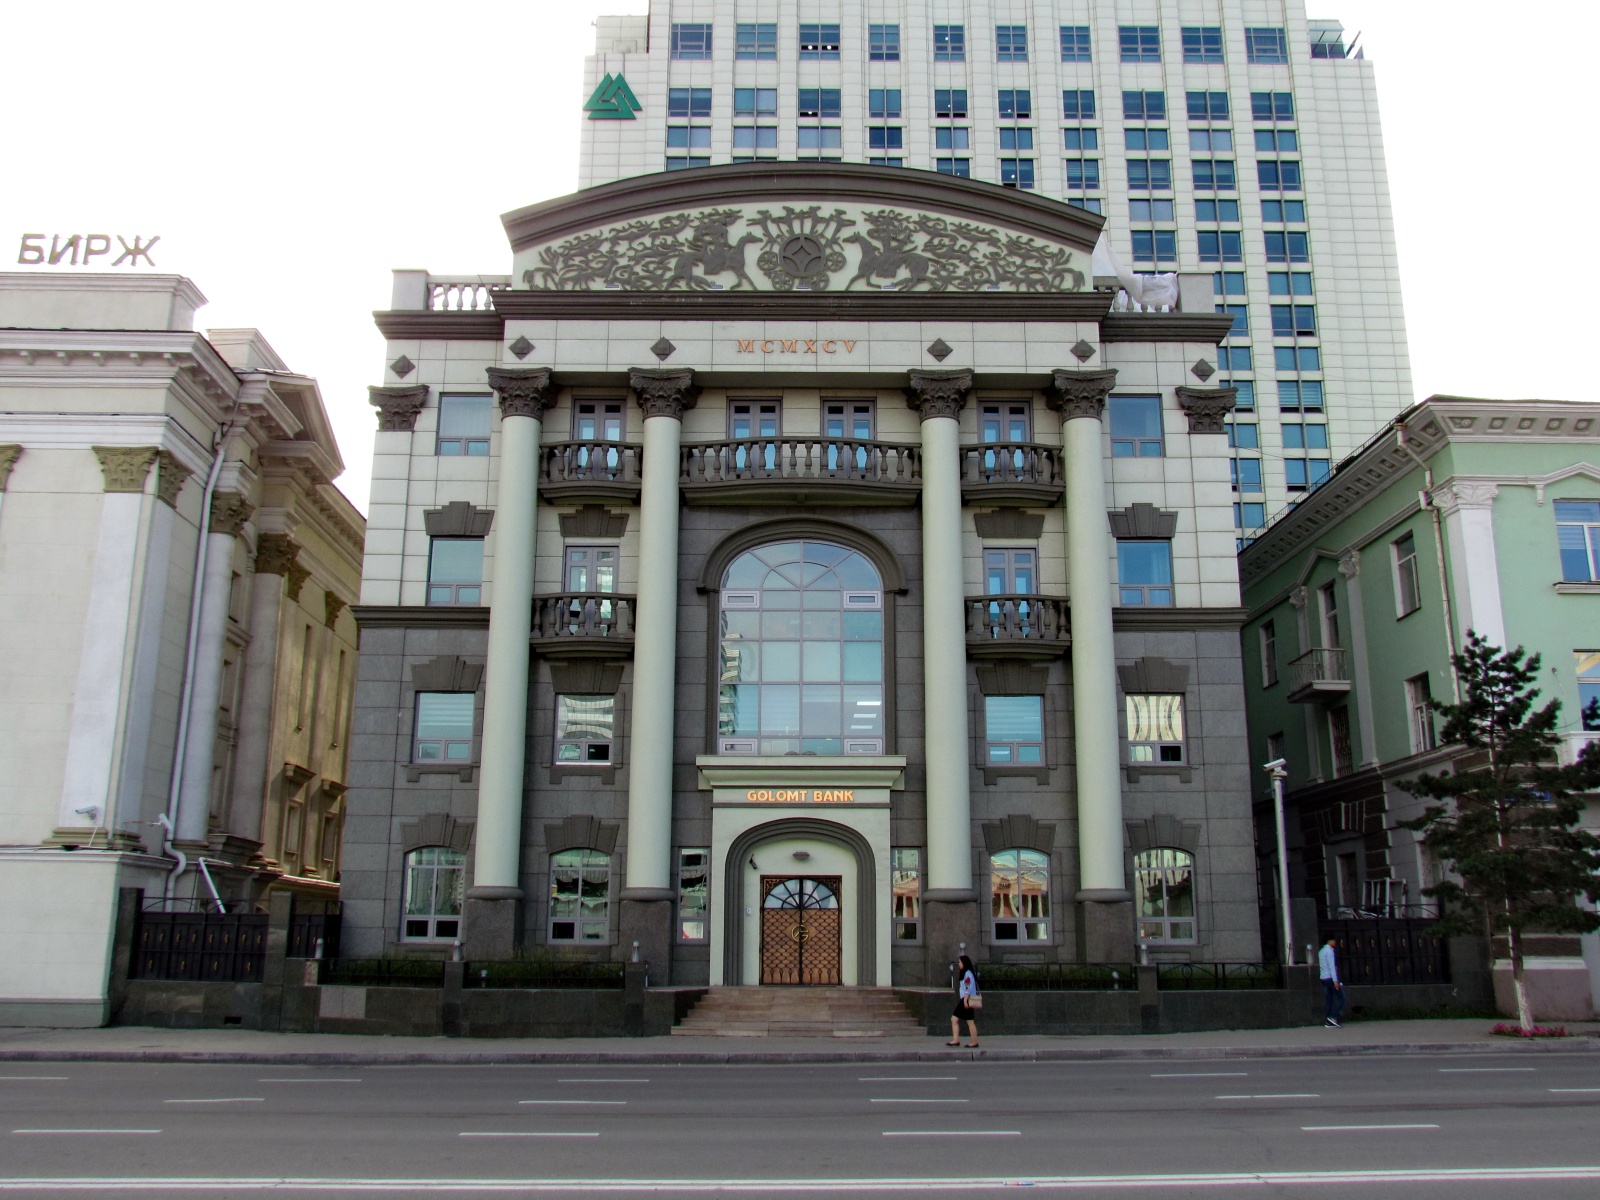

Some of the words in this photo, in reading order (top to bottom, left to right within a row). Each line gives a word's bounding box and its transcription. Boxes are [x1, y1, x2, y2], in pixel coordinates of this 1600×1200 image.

[18, 233, 161, 266] БИРЖ
[737, 339, 858, 353] MCMXCV
[747, 790, 808, 802] GOLOMT
[813, 790, 855, 802] BANK
